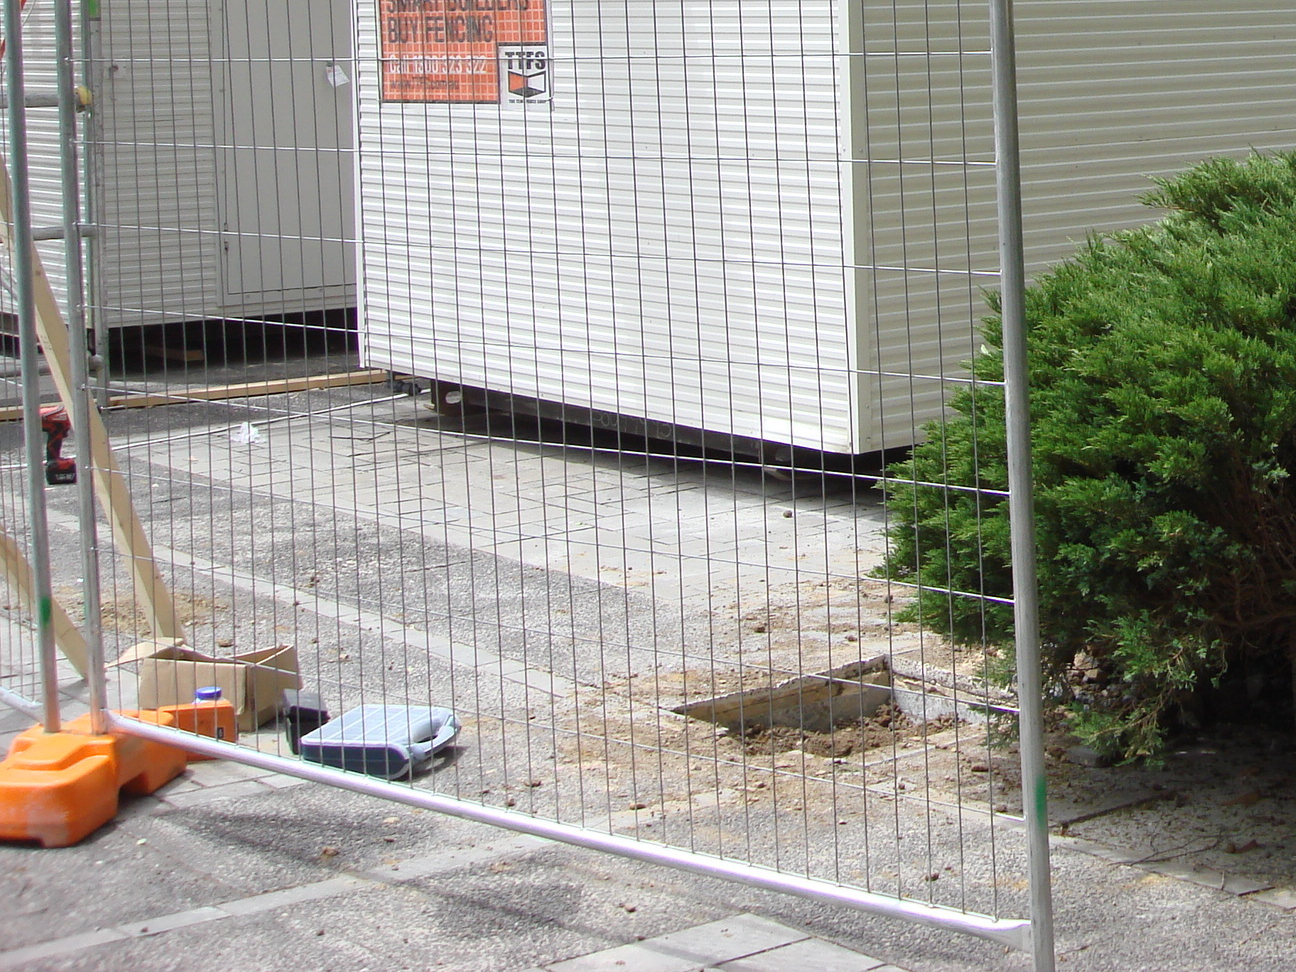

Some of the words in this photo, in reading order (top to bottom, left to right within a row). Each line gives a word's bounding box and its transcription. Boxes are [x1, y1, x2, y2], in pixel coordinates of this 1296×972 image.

[387, 16, 419, 43] BUY
[425, 14, 493, 42] FENCING
[389, 54, 410, 74] Call
[413, 55, 439, 74] 1300
[441, 54, 463, 74] 323
[465, 54, 487, 74] 322
[505, 51, 546, 70] TTFS
